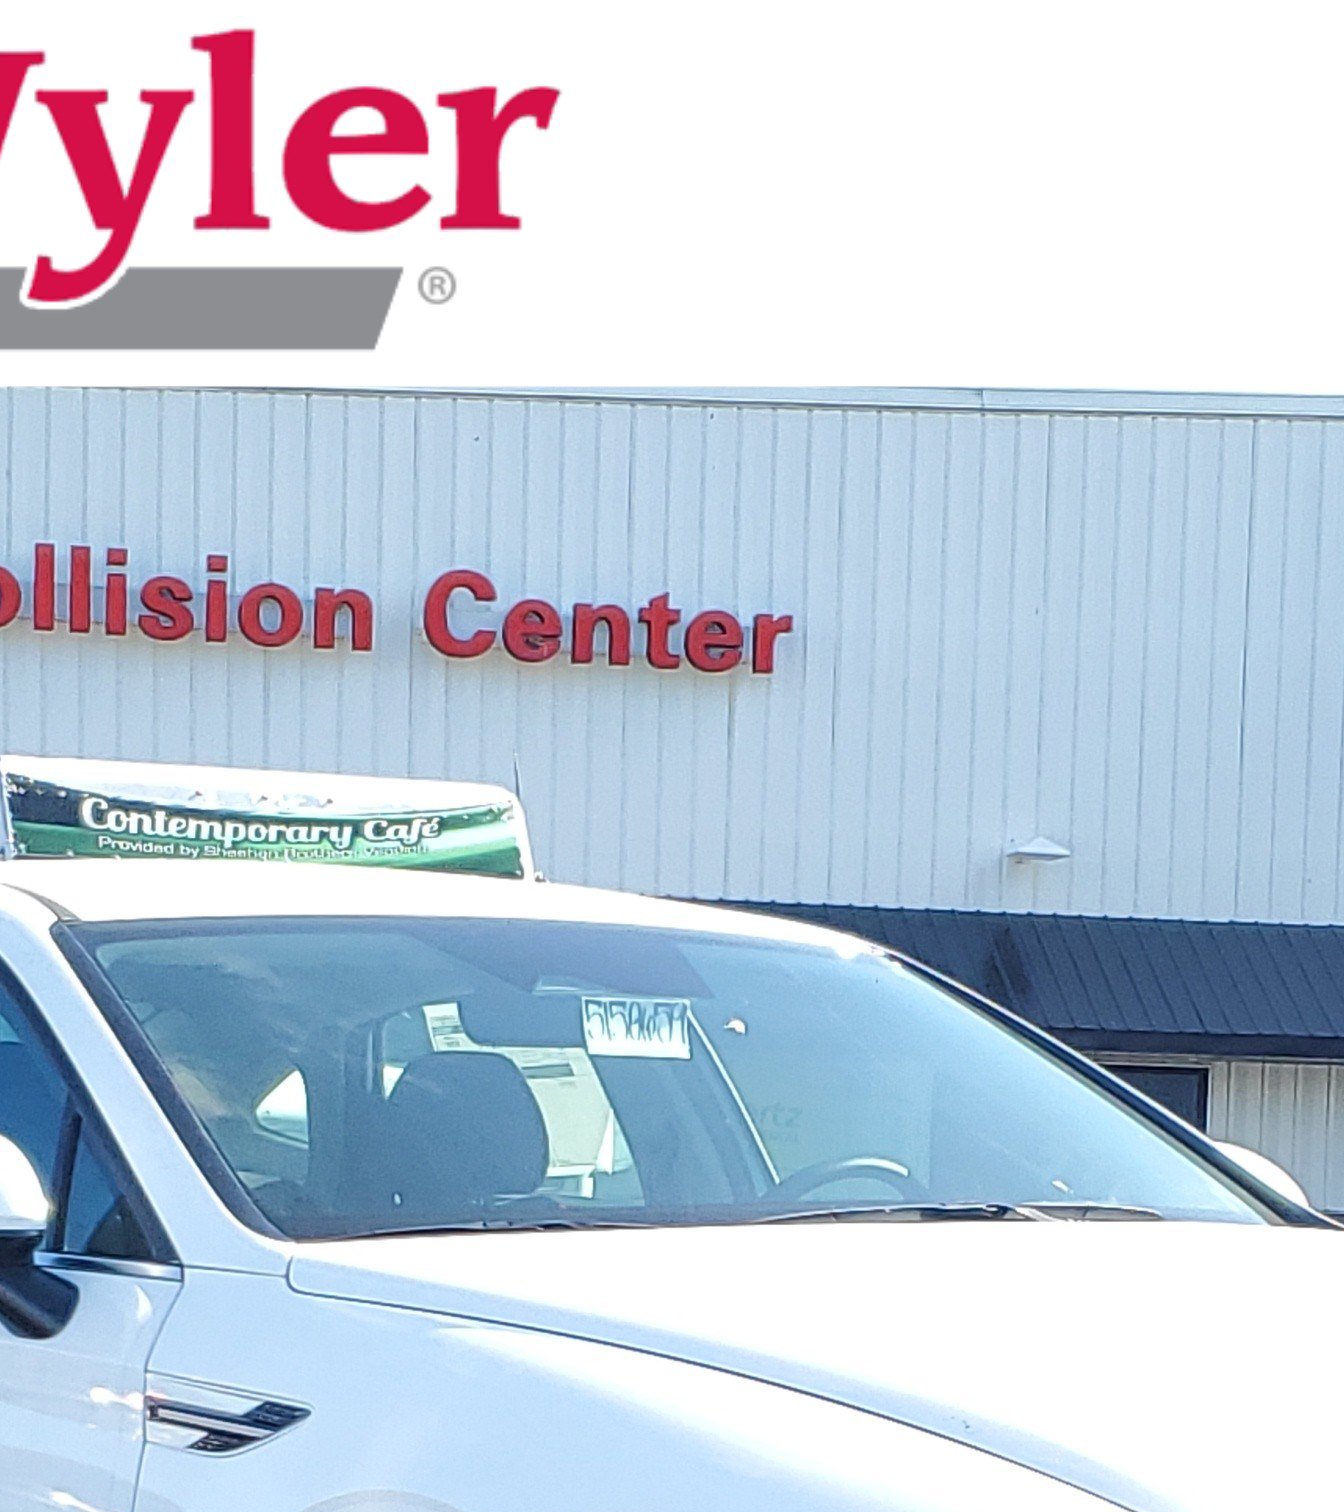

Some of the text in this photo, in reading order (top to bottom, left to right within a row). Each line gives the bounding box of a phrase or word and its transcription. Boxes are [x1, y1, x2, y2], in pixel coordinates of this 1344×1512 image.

[422, 569, 794, 674] Center
[79, 796, 442, 849] Contemporary Café
[97, 835, 175, 856] Provided
[179, 840, 201, 859] by
